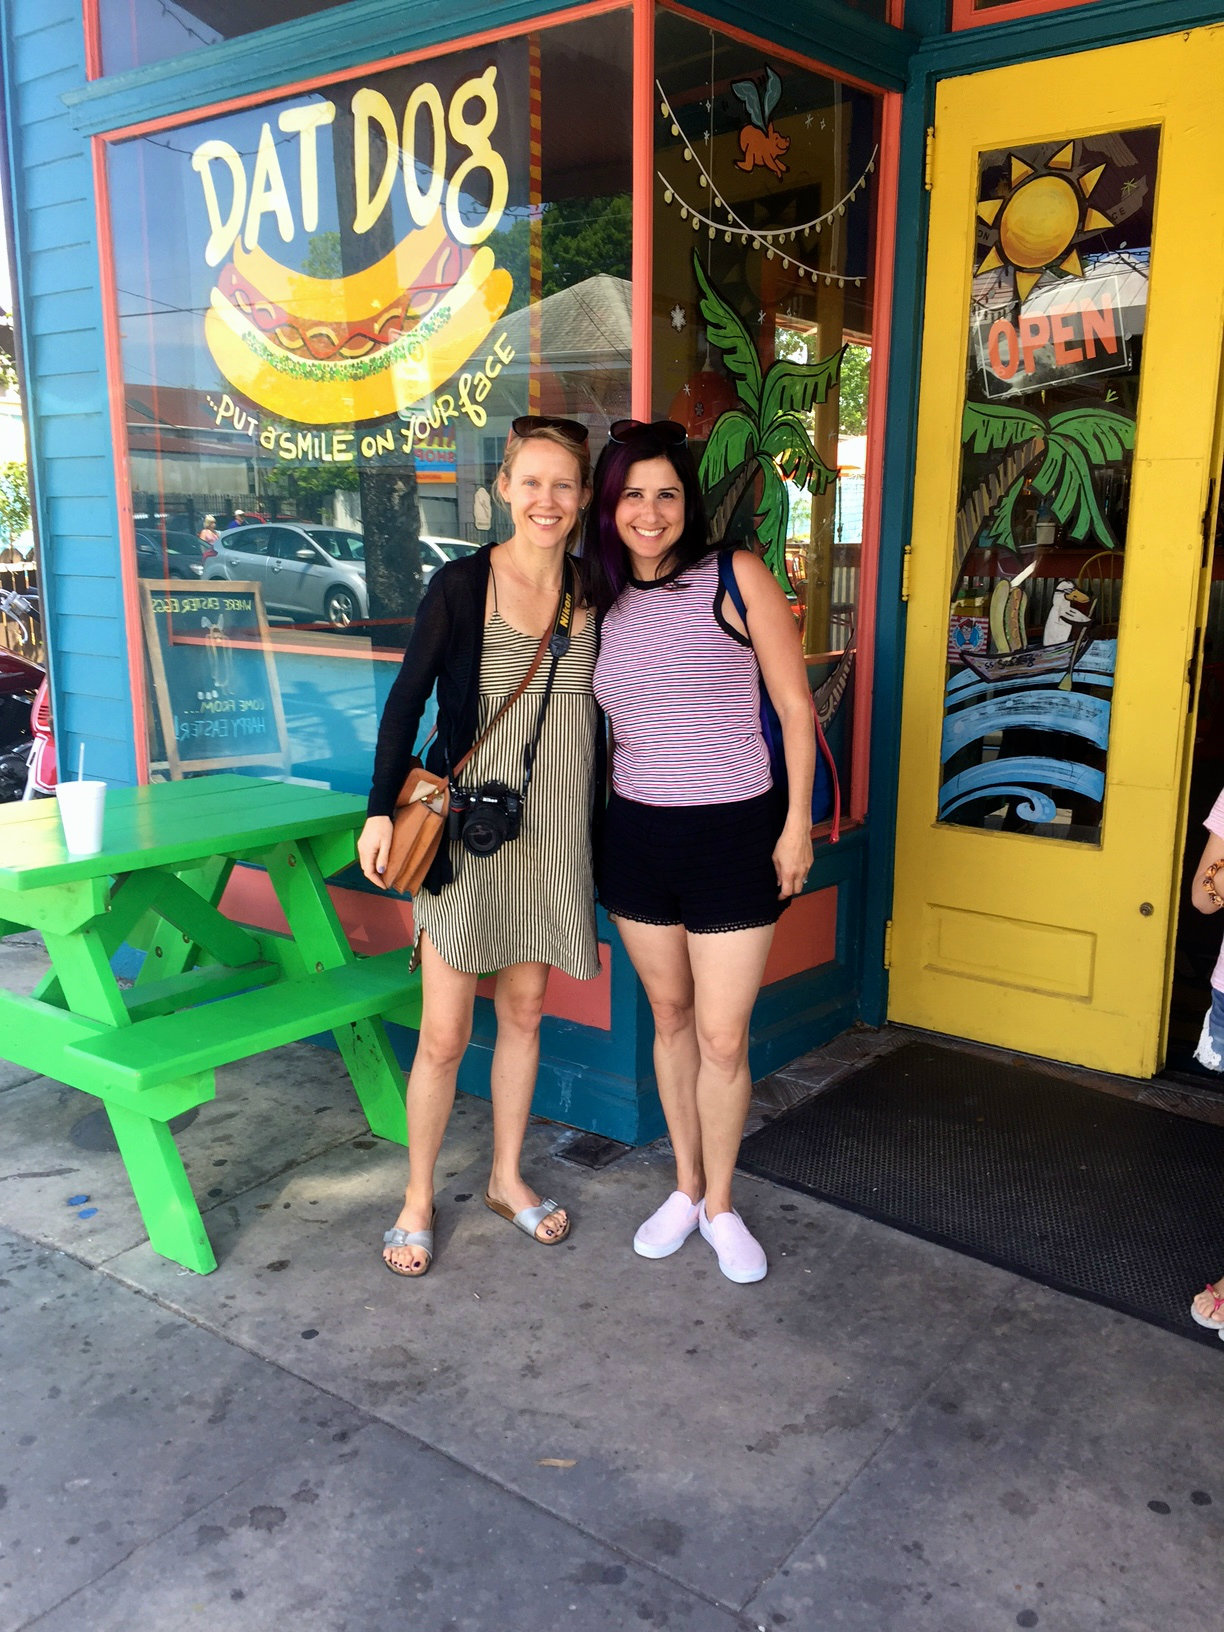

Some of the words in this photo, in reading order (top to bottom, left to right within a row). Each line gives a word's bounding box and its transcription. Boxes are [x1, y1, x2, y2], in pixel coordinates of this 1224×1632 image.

[191, 100, 337, 268] DAT
[987, 292, 1118, 380] OPEN
[278, 431, 354, 462] SMILE
[361, 428, 395, 458] ON
[560, 592, 572, 628] Nikon
